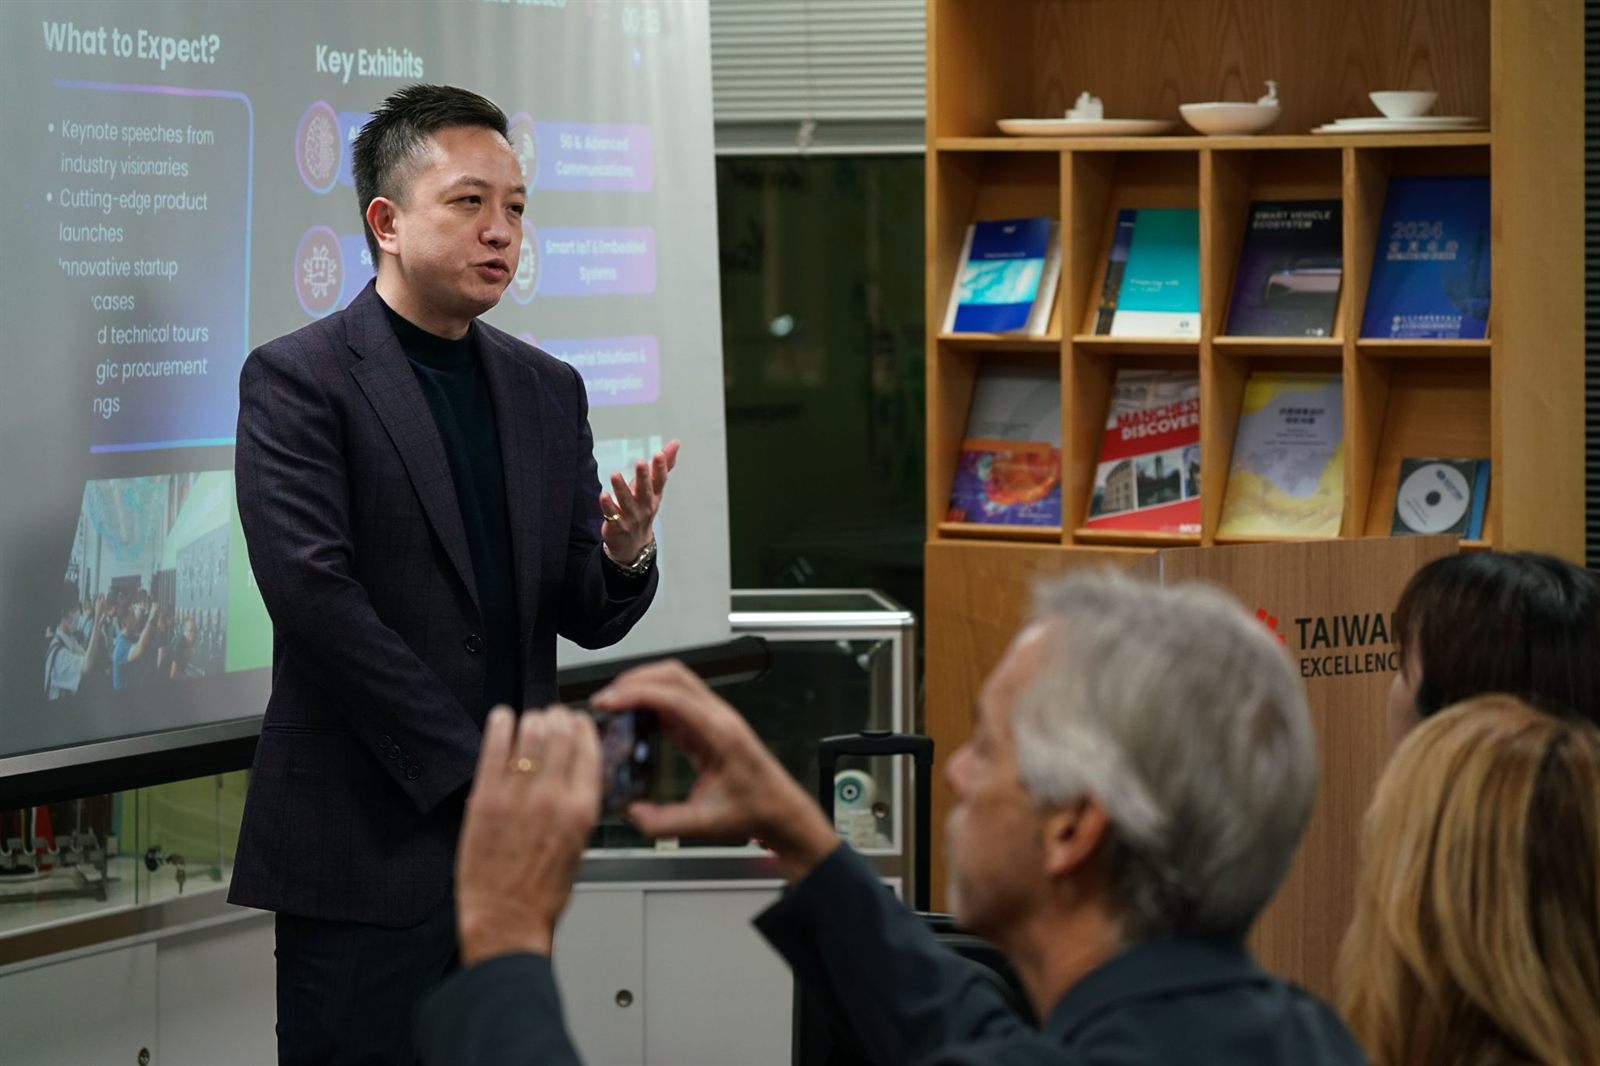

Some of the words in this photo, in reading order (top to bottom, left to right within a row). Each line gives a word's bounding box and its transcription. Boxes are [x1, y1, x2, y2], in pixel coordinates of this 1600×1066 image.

[43, 21, 108, 56] What
[112, 27, 133, 58] to
[137, 30, 221, 69] Expect?
[316, 45, 354, 84] Key
[358, 49, 424, 79] Exhibits
[62, 120, 119, 147] Keynote
[121, 125, 183, 150] speeches
[187, 123, 215, 145] from
[60, 154, 117, 181] industry
[120, 155, 189, 177] visionaries
[60, 188, 151, 214] Cutting-edge
[153, 193, 208, 213] product
[59, 223, 123, 244] launches
[545, 239, 575, 255] Smart
[134, 258, 178, 281] startup
[578, 266, 617, 286] Systems
[93, 294, 135, 311] cases
[111, 324, 169, 345] technical
[172, 326, 209, 343] tours
[122, 357, 208, 384] procurement
[1301, 652, 1399, 677] EXCELLENC
